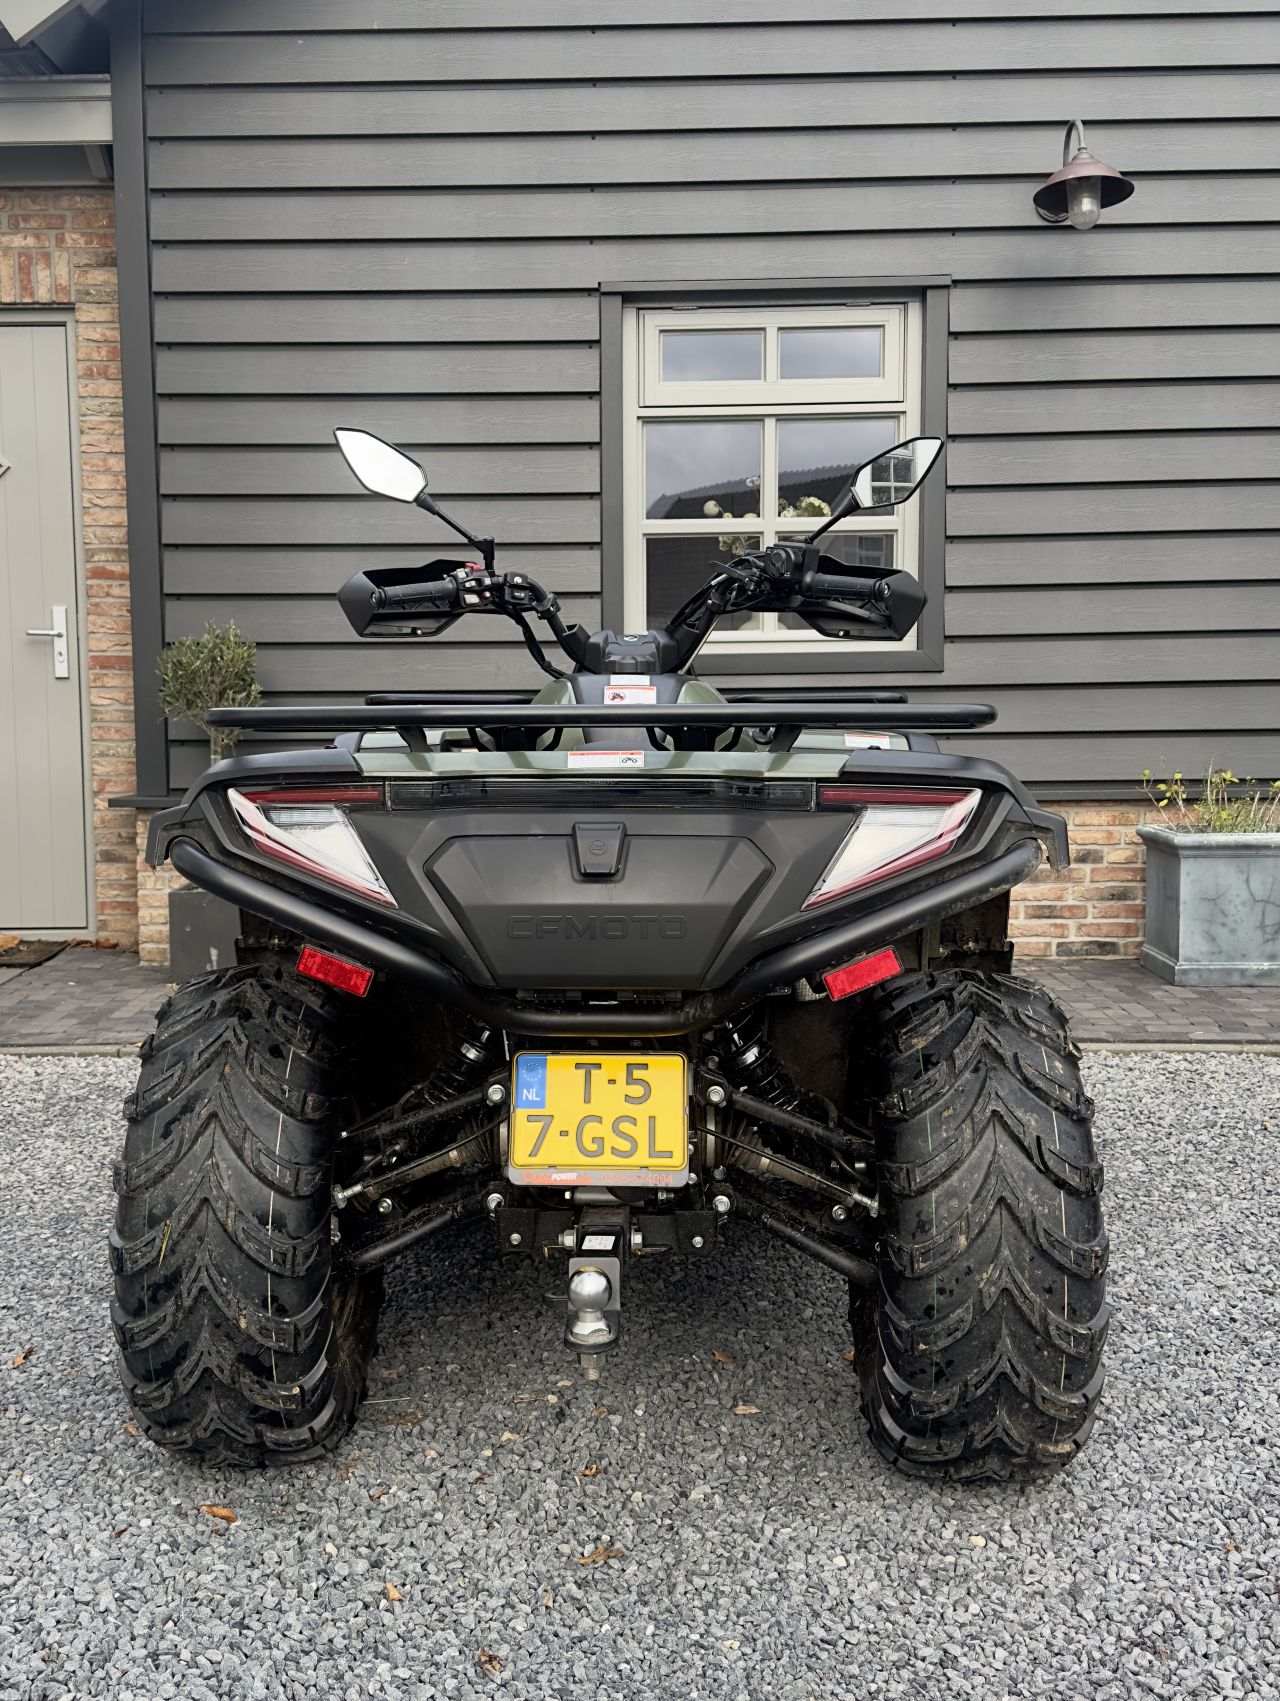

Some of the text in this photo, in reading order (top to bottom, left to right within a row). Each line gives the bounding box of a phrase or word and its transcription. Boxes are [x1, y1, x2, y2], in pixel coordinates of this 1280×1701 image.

[506, 915, 688, 940] CFMOTO
[522, 1088, 541, 1101] NL
[575, 1063, 652, 1105] T-5
[526, 1115, 674, 1158] 7-GSL
